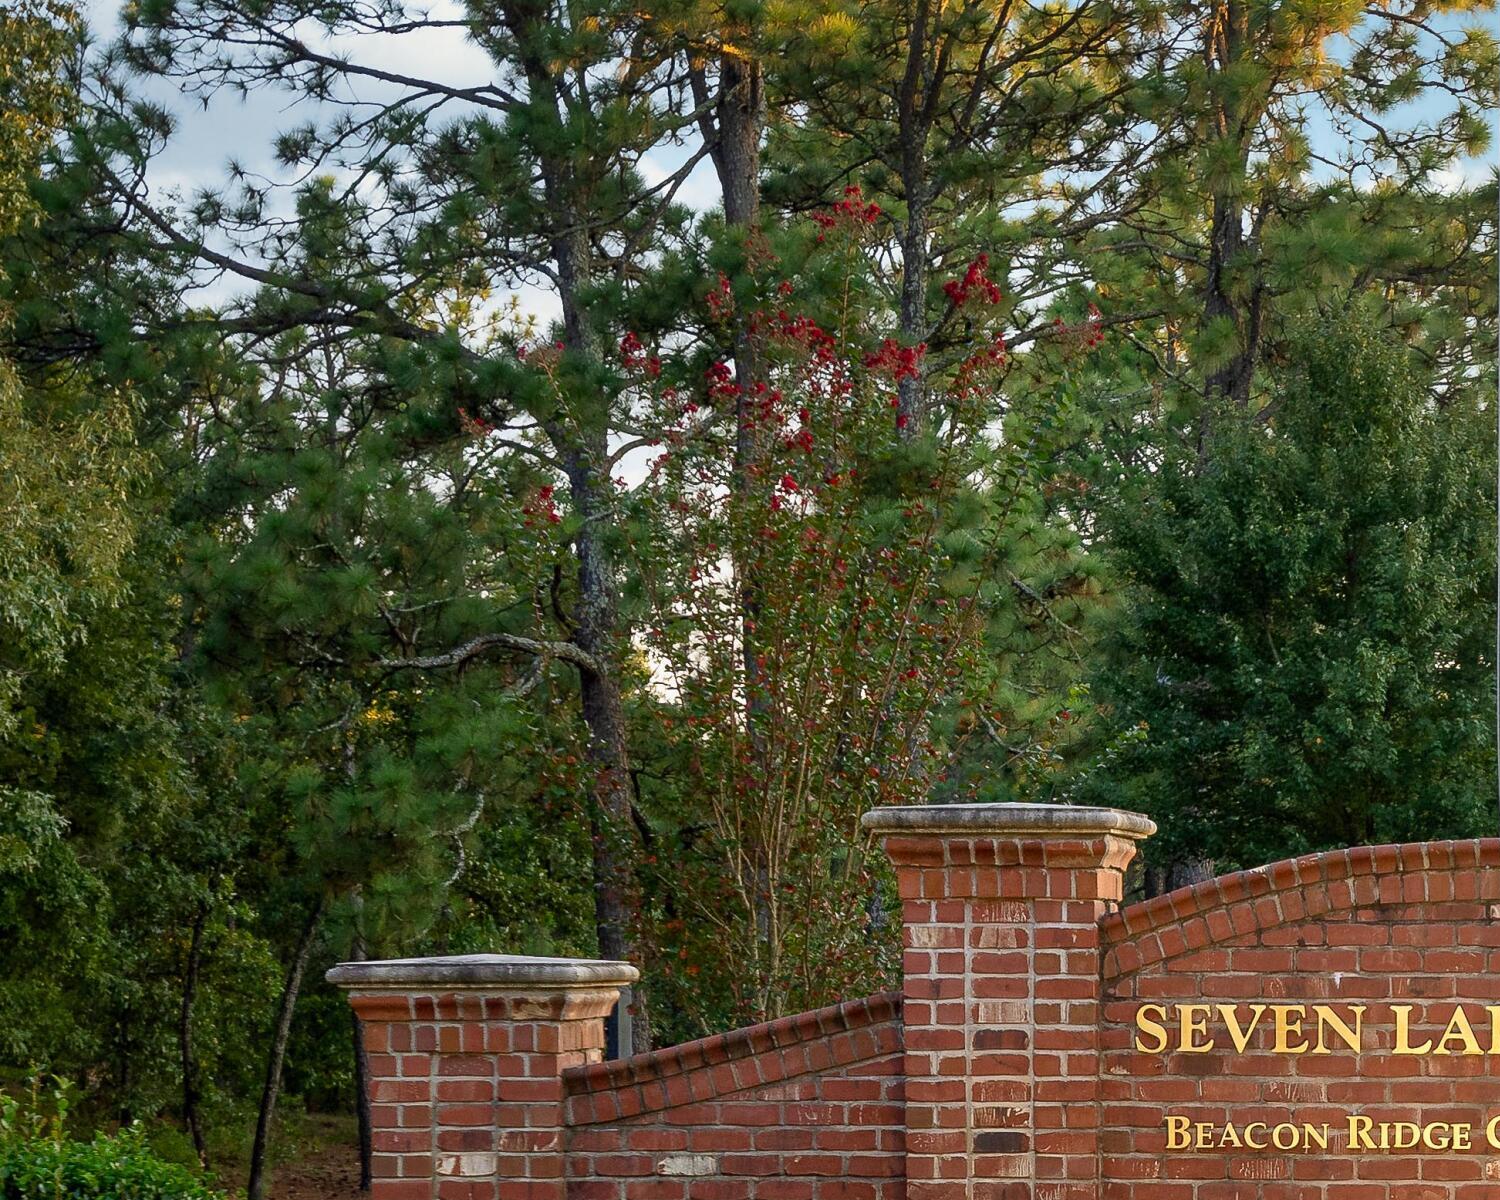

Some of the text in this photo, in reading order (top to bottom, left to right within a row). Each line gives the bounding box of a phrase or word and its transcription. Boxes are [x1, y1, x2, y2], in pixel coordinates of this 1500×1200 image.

[1134, 1003, 1367, 1056] SEVEN
[1164, 1115, 1330, 1151] BEACON
[1345, 1115, 1473, 1151] RIDGE
